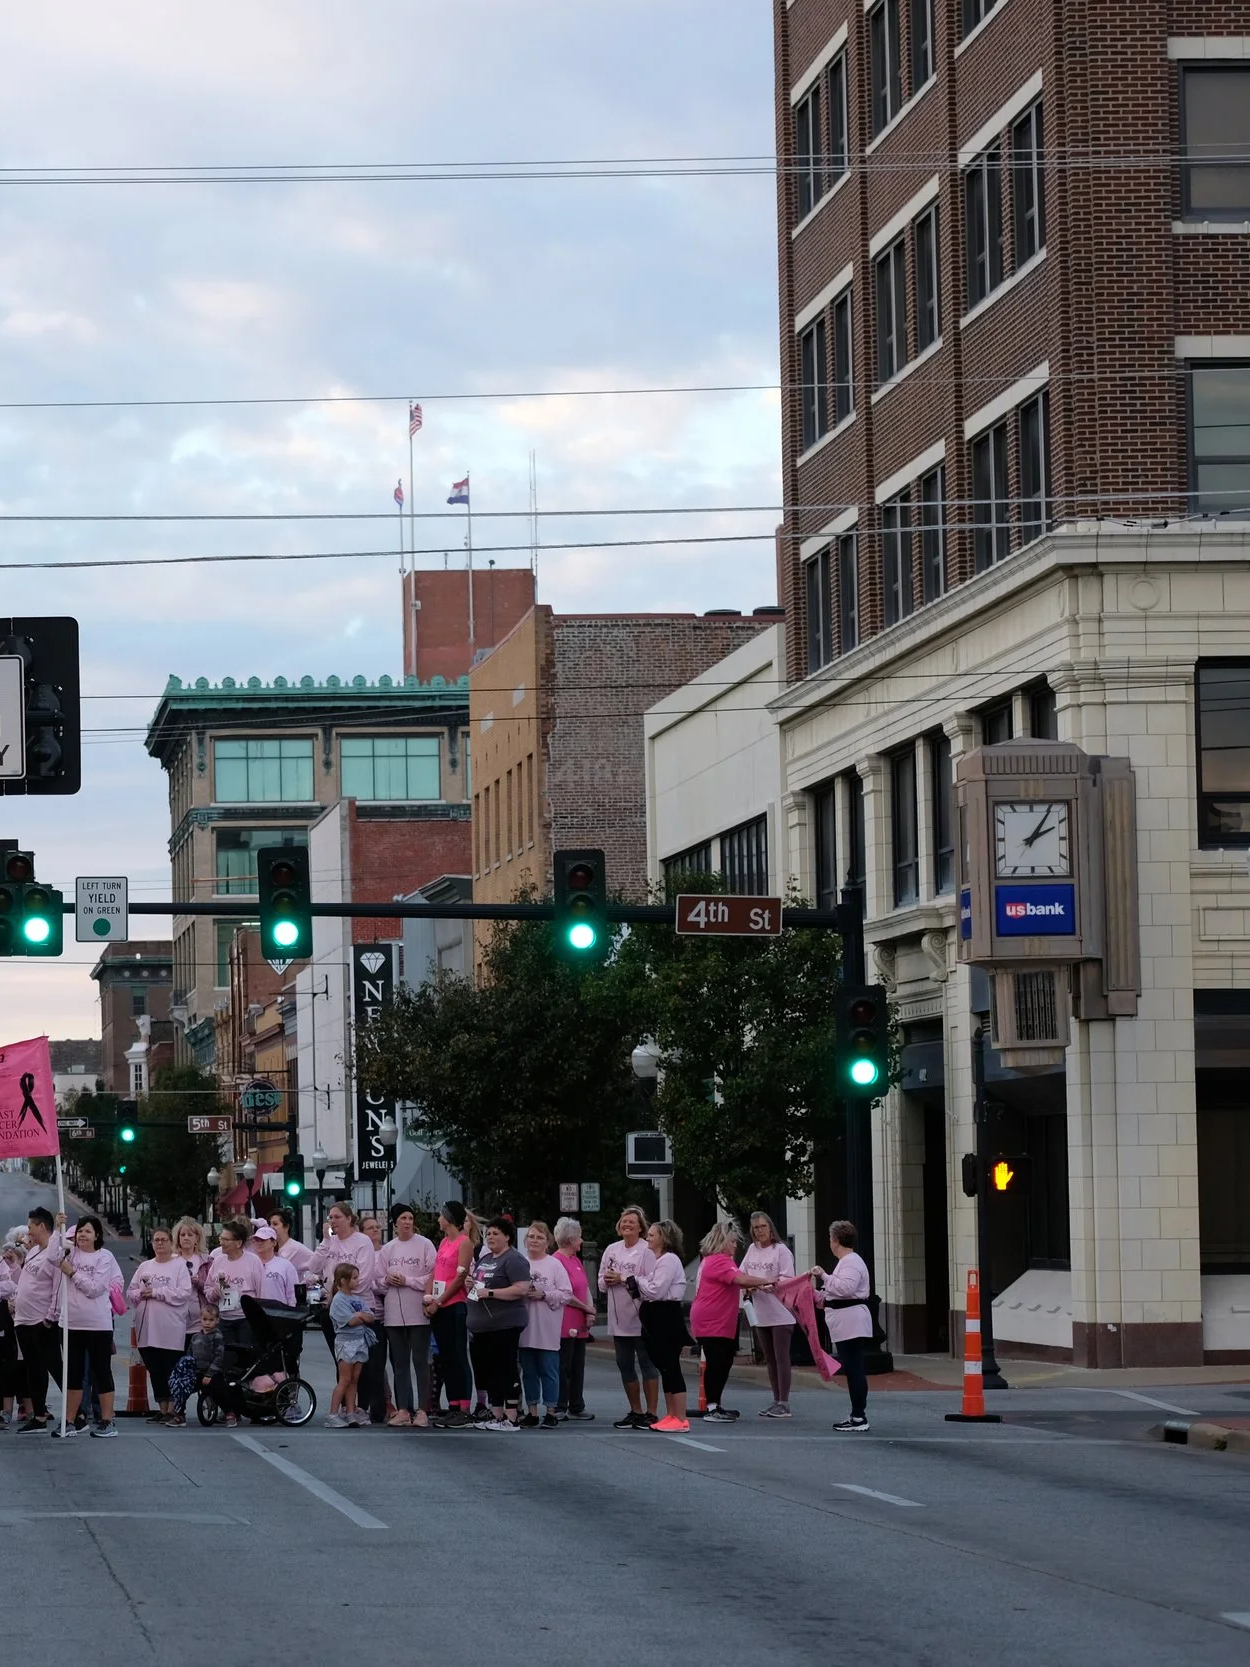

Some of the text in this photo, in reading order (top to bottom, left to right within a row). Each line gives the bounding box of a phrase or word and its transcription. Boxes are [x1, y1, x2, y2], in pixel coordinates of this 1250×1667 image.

[82, 882, 122, 891] LEFT TURN
[88, 893, 116, 904] YIELD
[83, 906, 121, 915] ON GREEN
[686, 900, 771, 930] 4th St
[1005, 902, 1065, 917] usbank
[361, 979, 390, 1158] NEN'S
[192, 1117, 228, 1131] 5th St
[71, 1129, 83, 1138] 6th
[222, 1298, 232, 1306] 71
